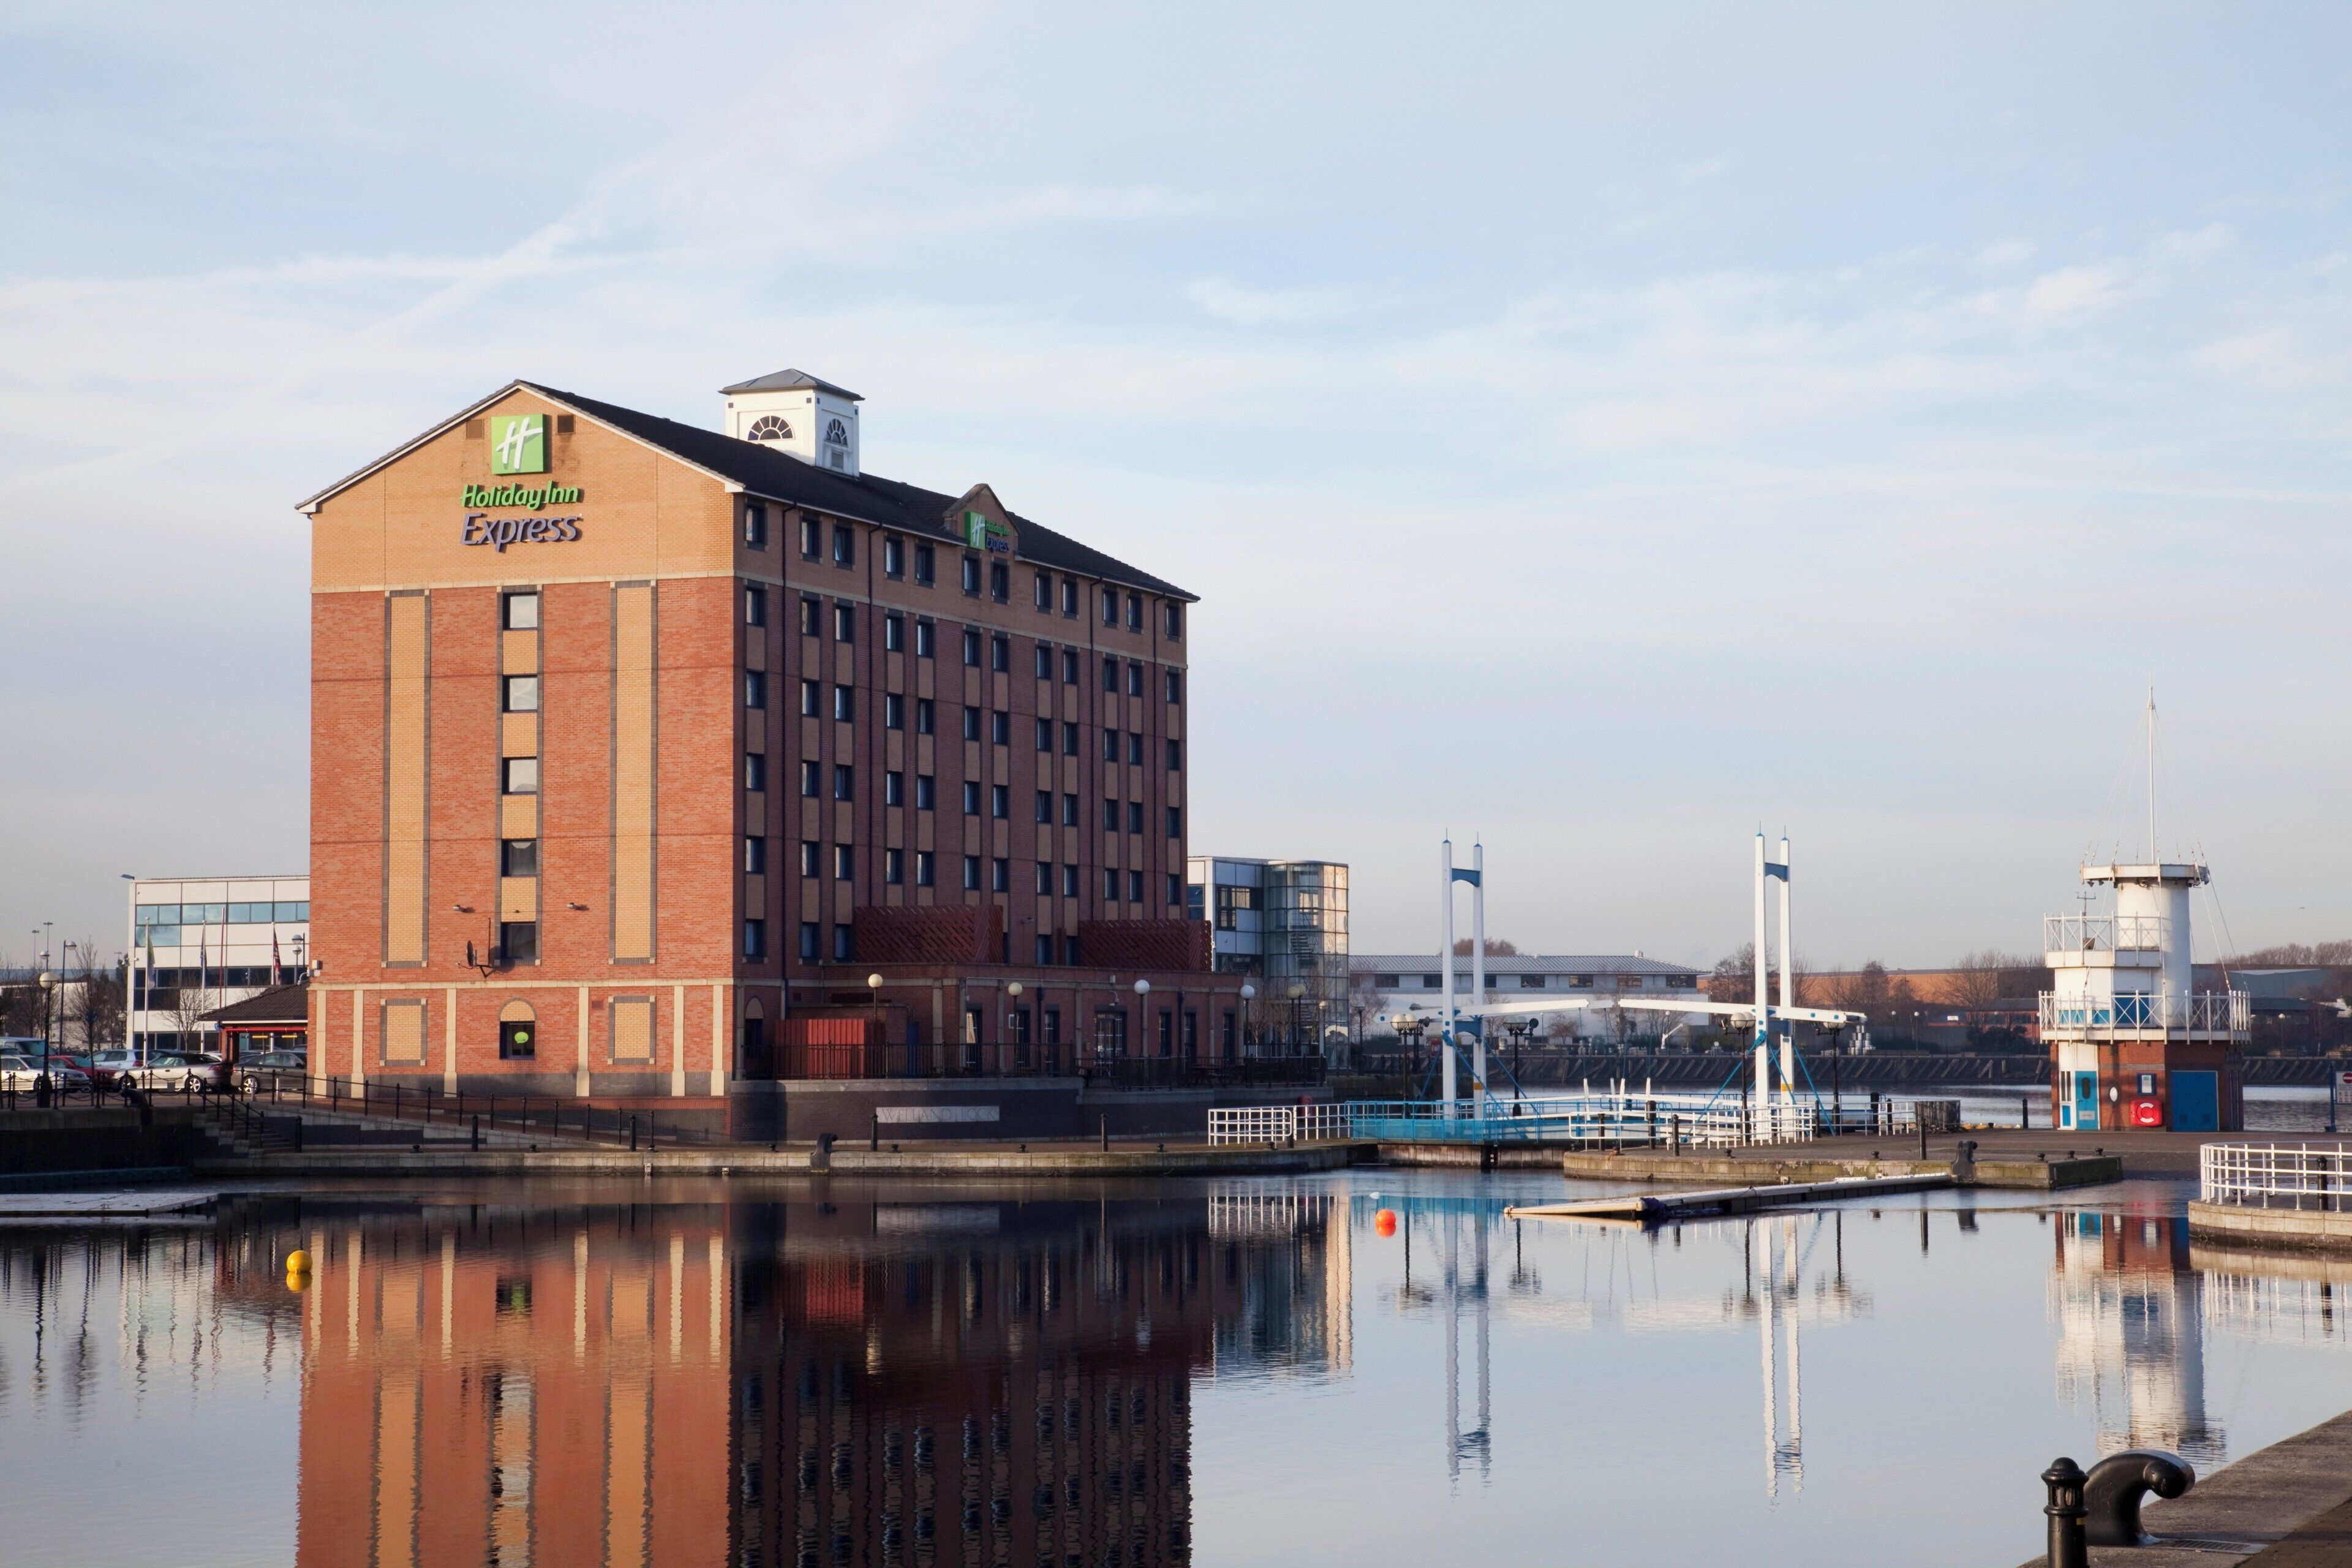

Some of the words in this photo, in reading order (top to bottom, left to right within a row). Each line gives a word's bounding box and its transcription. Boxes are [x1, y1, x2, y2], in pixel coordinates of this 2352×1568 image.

[461, 483, 543, 510] Holiday
[545, 480, 578, 503] Inn
[461, 512, 579, 552] Express
[986, 519, 1003, 537] Holiday
[986, 536, 1009, 552] Express
[882, 1108, 952, 1121] WELLAND
[962, 1107, 996, 1120] LOCK
